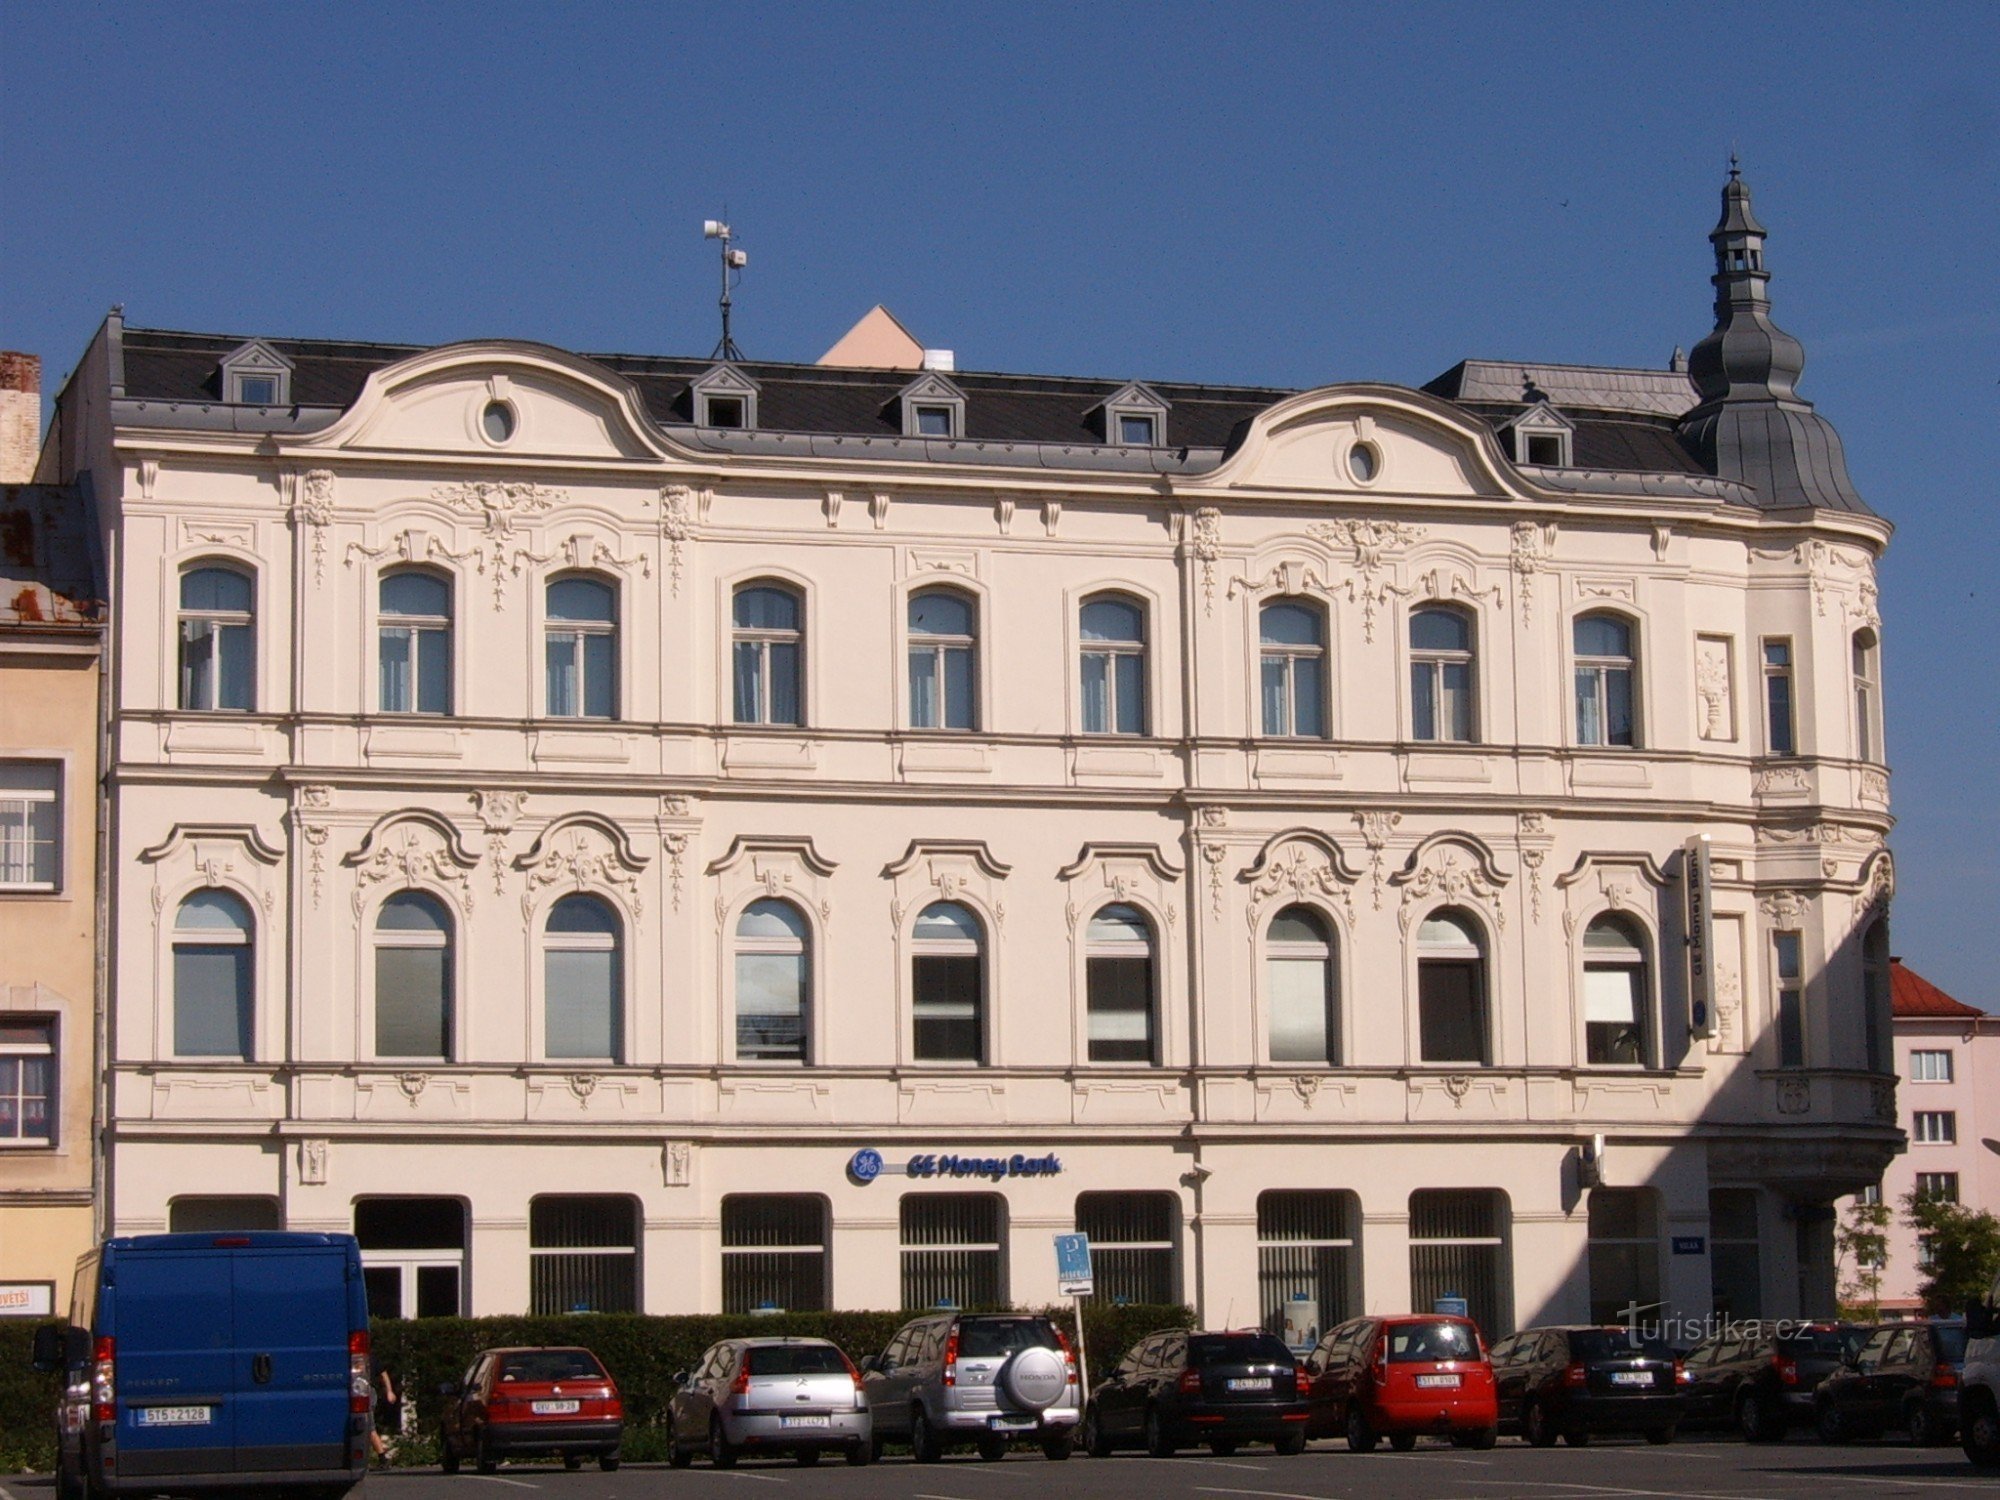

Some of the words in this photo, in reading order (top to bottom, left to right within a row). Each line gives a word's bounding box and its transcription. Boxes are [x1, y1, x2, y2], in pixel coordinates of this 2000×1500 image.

[1689, 846, 1699, 889] Bank
[1691, 893, 1702, 948] Money
[908, 1155, 938, 1176] GE
[940, 1155, 1007, 1180] Money
[1010, 1153, 1062, 1176] Bank
[147, 1409, 169, 1421] 5T5
[177, 1408, 205, 1420] 2128
